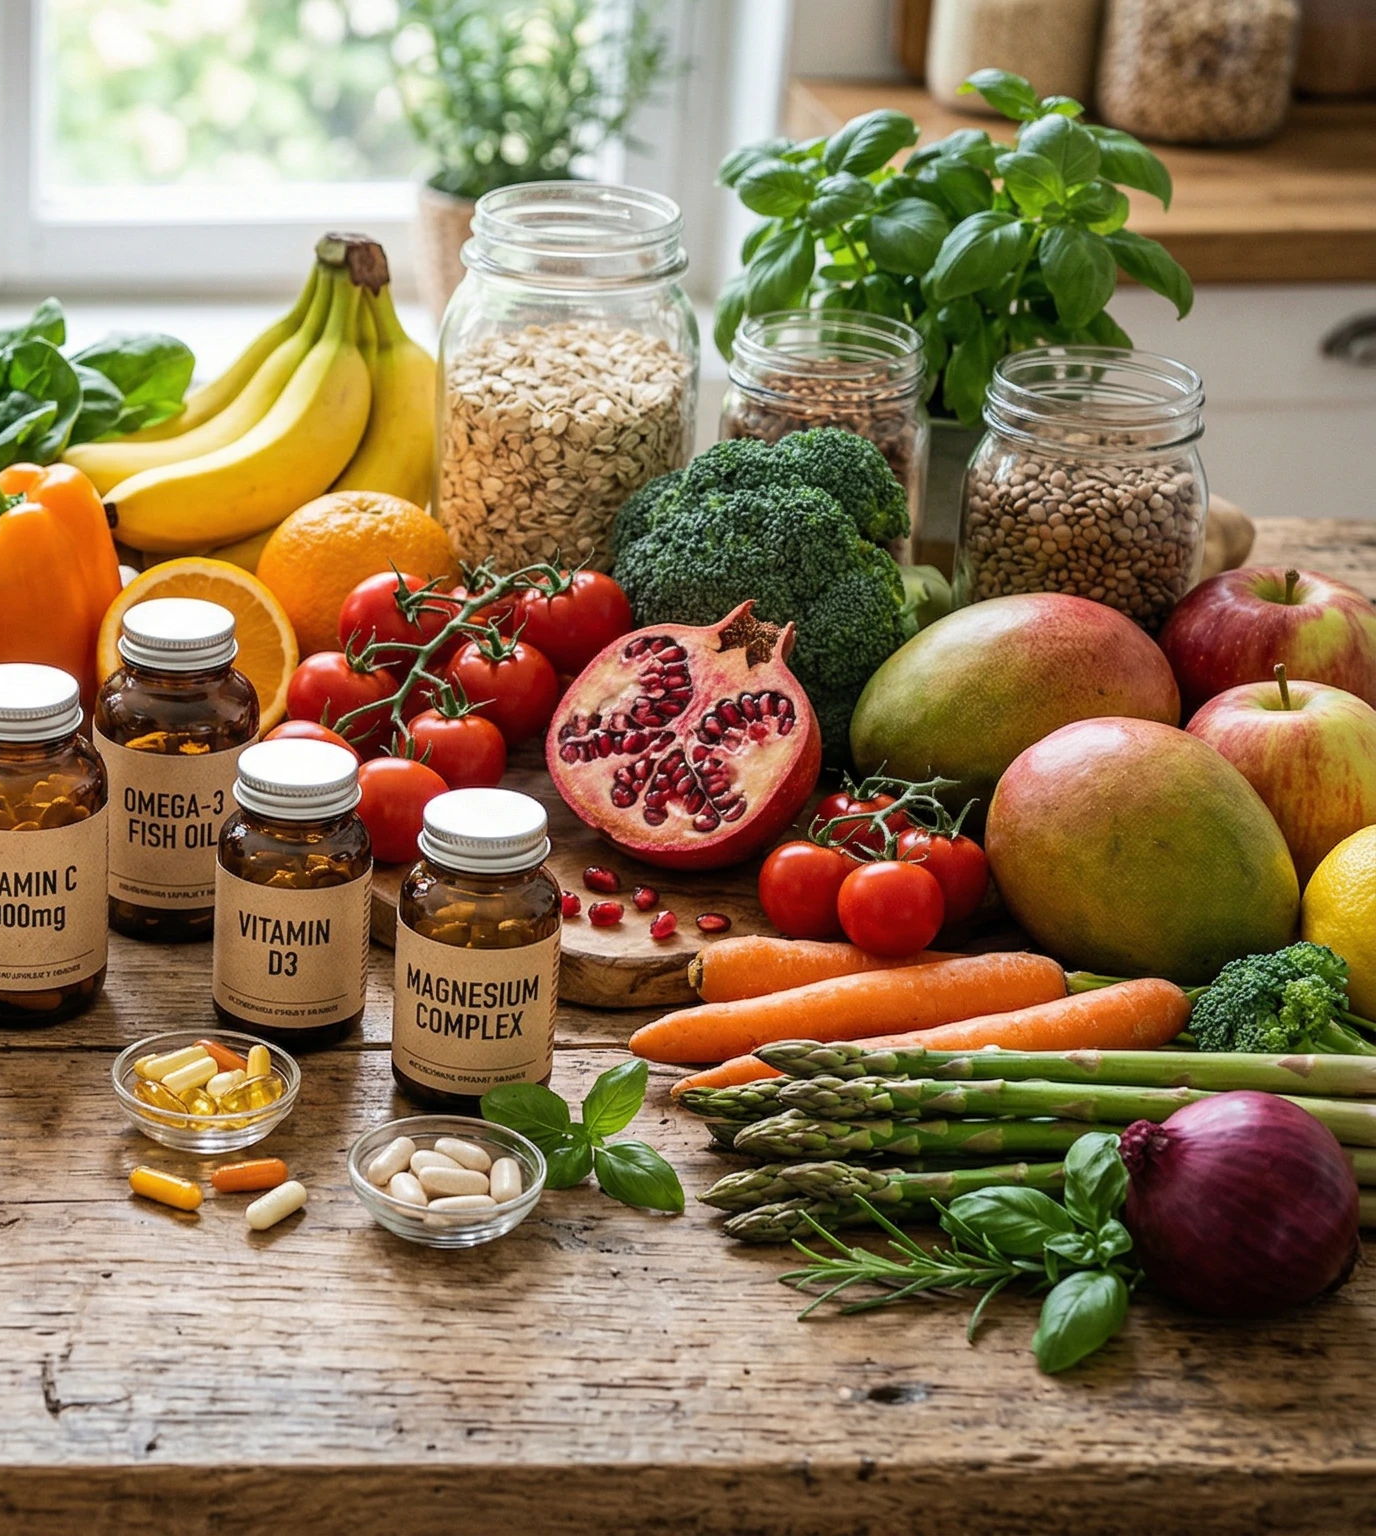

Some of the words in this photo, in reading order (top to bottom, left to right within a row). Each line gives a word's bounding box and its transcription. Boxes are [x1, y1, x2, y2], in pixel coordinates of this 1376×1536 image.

[124, 787, 224, 819] OMEGA-3
[128, 818, 176, 850] FISH
[184, 822, 218, 849] OIL
[65, 865, 78, 892] C
[238, 909, 331, 946] VITAMIN
[268, 949, 299, 977] D3
[406, 962, 539, 1009] MAGNESIUM
[415, 1001, 524, 1041] COMPLEX
